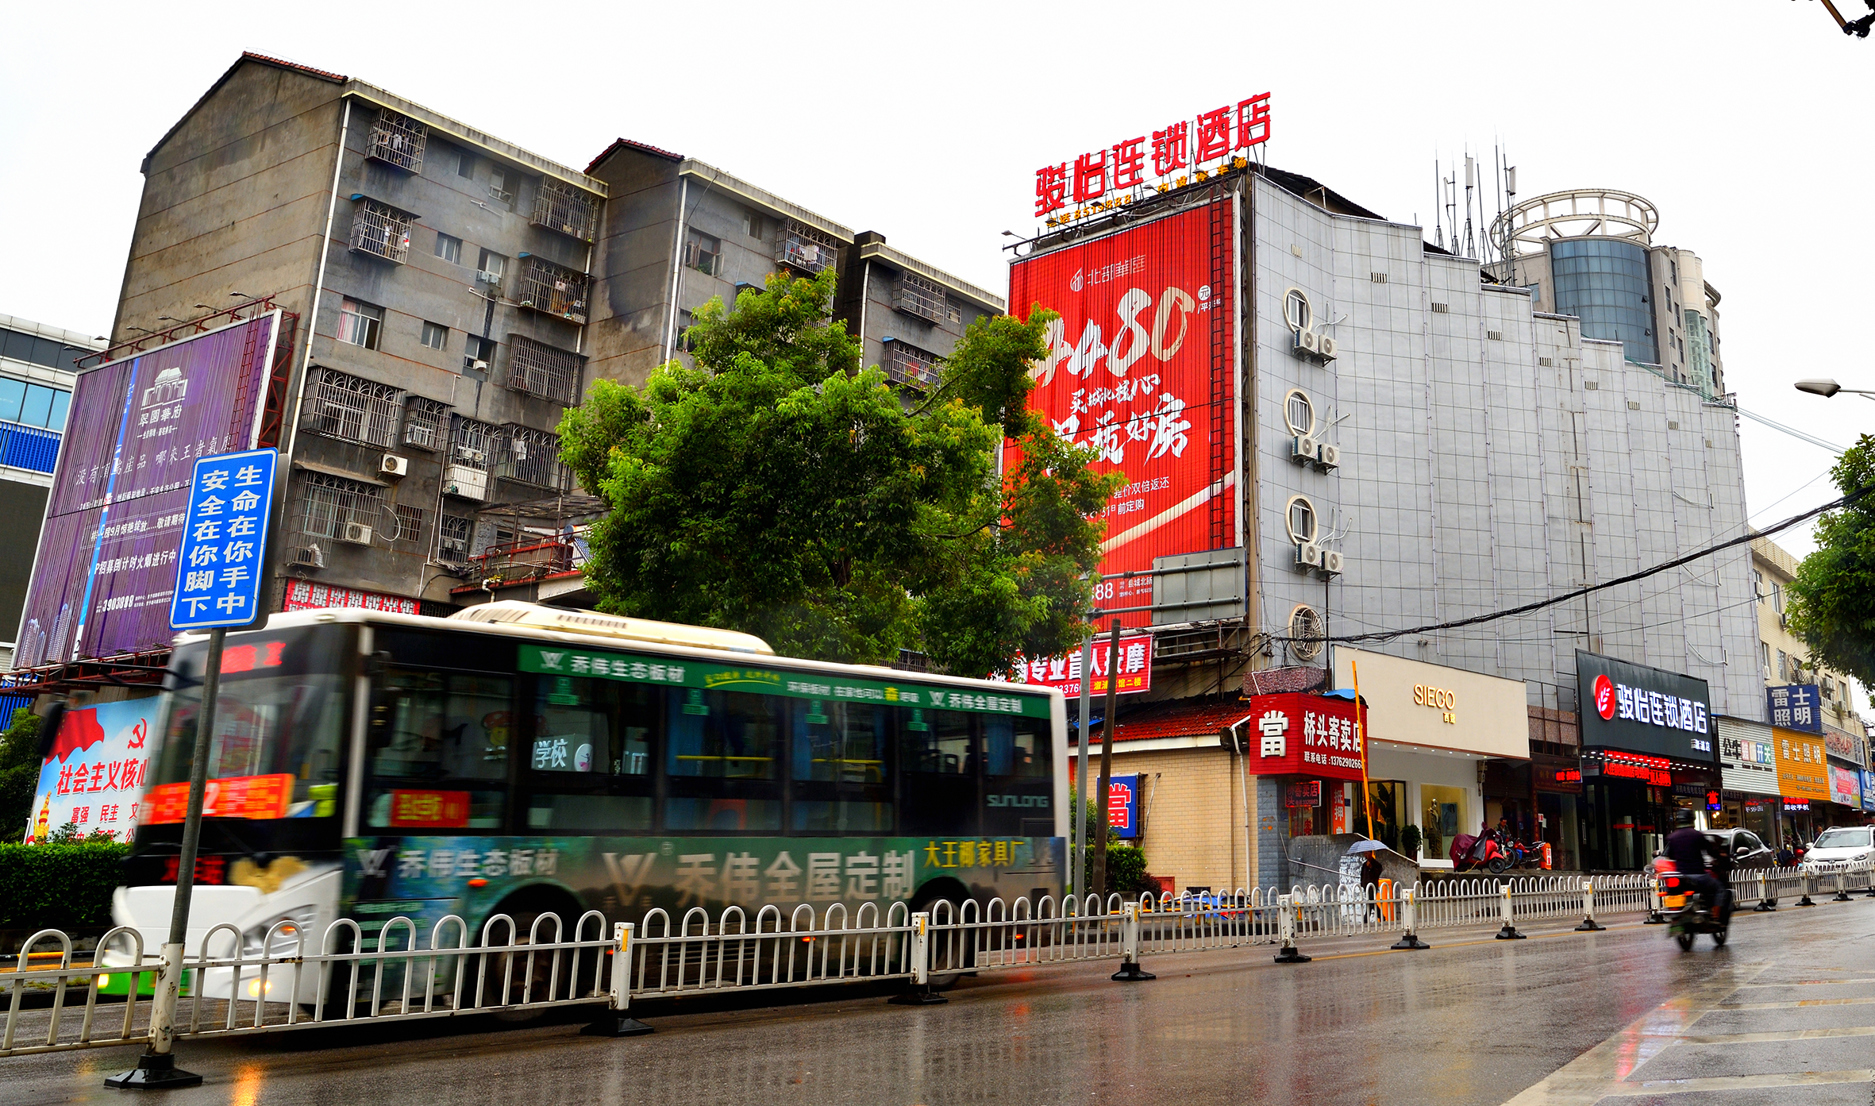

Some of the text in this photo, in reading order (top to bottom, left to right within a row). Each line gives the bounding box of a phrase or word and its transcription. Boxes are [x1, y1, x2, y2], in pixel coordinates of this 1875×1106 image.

[1034, 91, 1271, 218] 骏怡连锁酒店
[1027, 286, 1195, 388] 4480
[181, 470, 230, 618] 安全在你脚下
[216, 465, 263, 614] 生命在你手中
[1091, 582, 1113, 600] 88
[1094, 677, 1141, 690] 溆浦馆二楼
[1414, 683, 1456, 710] SIEGO
[1771, 688, 1811, 708] 雷士
[1617, 683, 1708, 734] 骏怡连锁酒店
[1773, 707, 1812, 727] 照明
[1259, 710, 1289, 758] 當
[1304, 710, 1363, 753] 桥头寄卖店
[536, 738, 568, 769] 学校
[1781, 739, 1821, 764] 雷士照明
[71, 806, 89, 824] 富强
[100, 804, 119, 822] 民主
